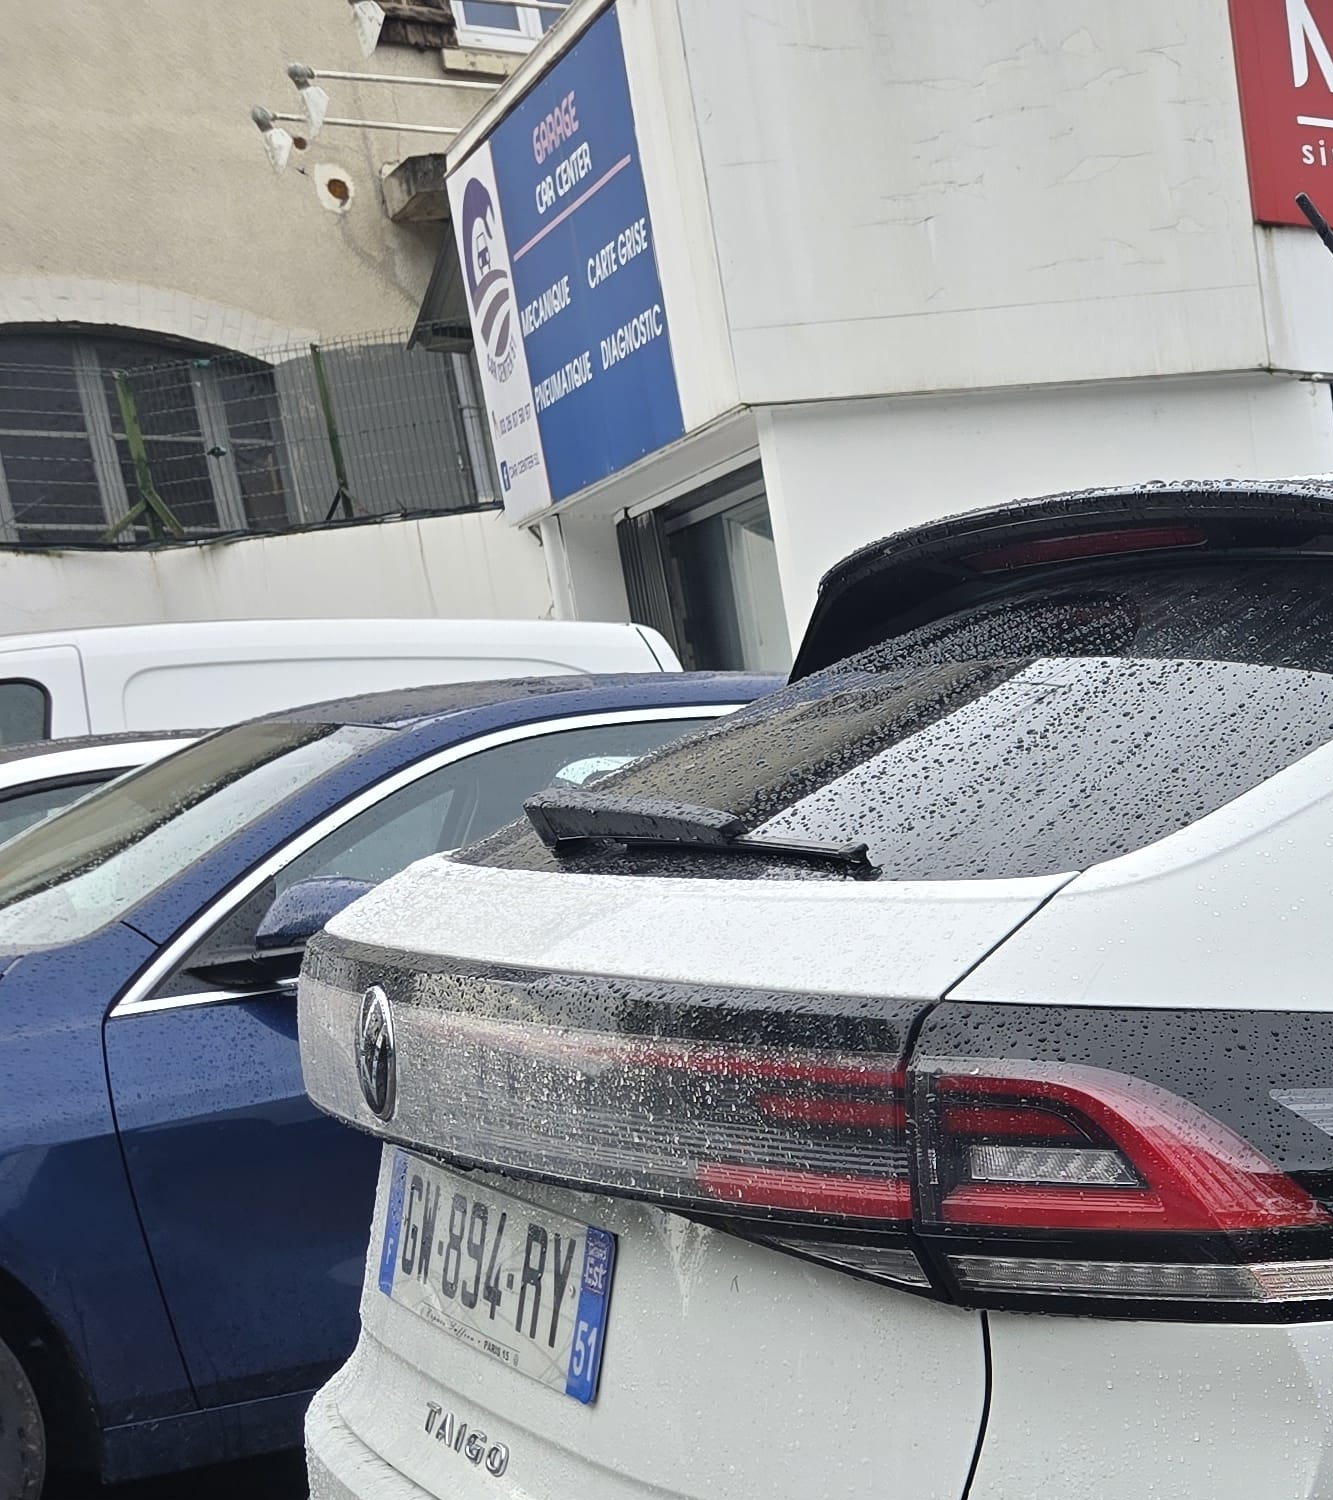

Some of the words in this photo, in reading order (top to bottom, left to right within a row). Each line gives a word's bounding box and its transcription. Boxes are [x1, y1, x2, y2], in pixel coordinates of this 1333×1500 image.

[532, 90, 579, 165] GARAGE
[535, 175, 556, 215] CAR
[555, 141, 592, 197] CENTER
[587, 240, 618, 289] CARTE
[617, 217, 648, 266] GRISE
[520, 275, 571, 338] MECANIQUE
[600, 304, 663, 371] DIAGNOSTIC
[534, 350, 593, 414] PNEUMATIQUE
[401, 1174, 577, 1348] GW-894-RY
[572, 1320, 598, 1382] 51
[424, 1400, 510, 1478] TAIGO
